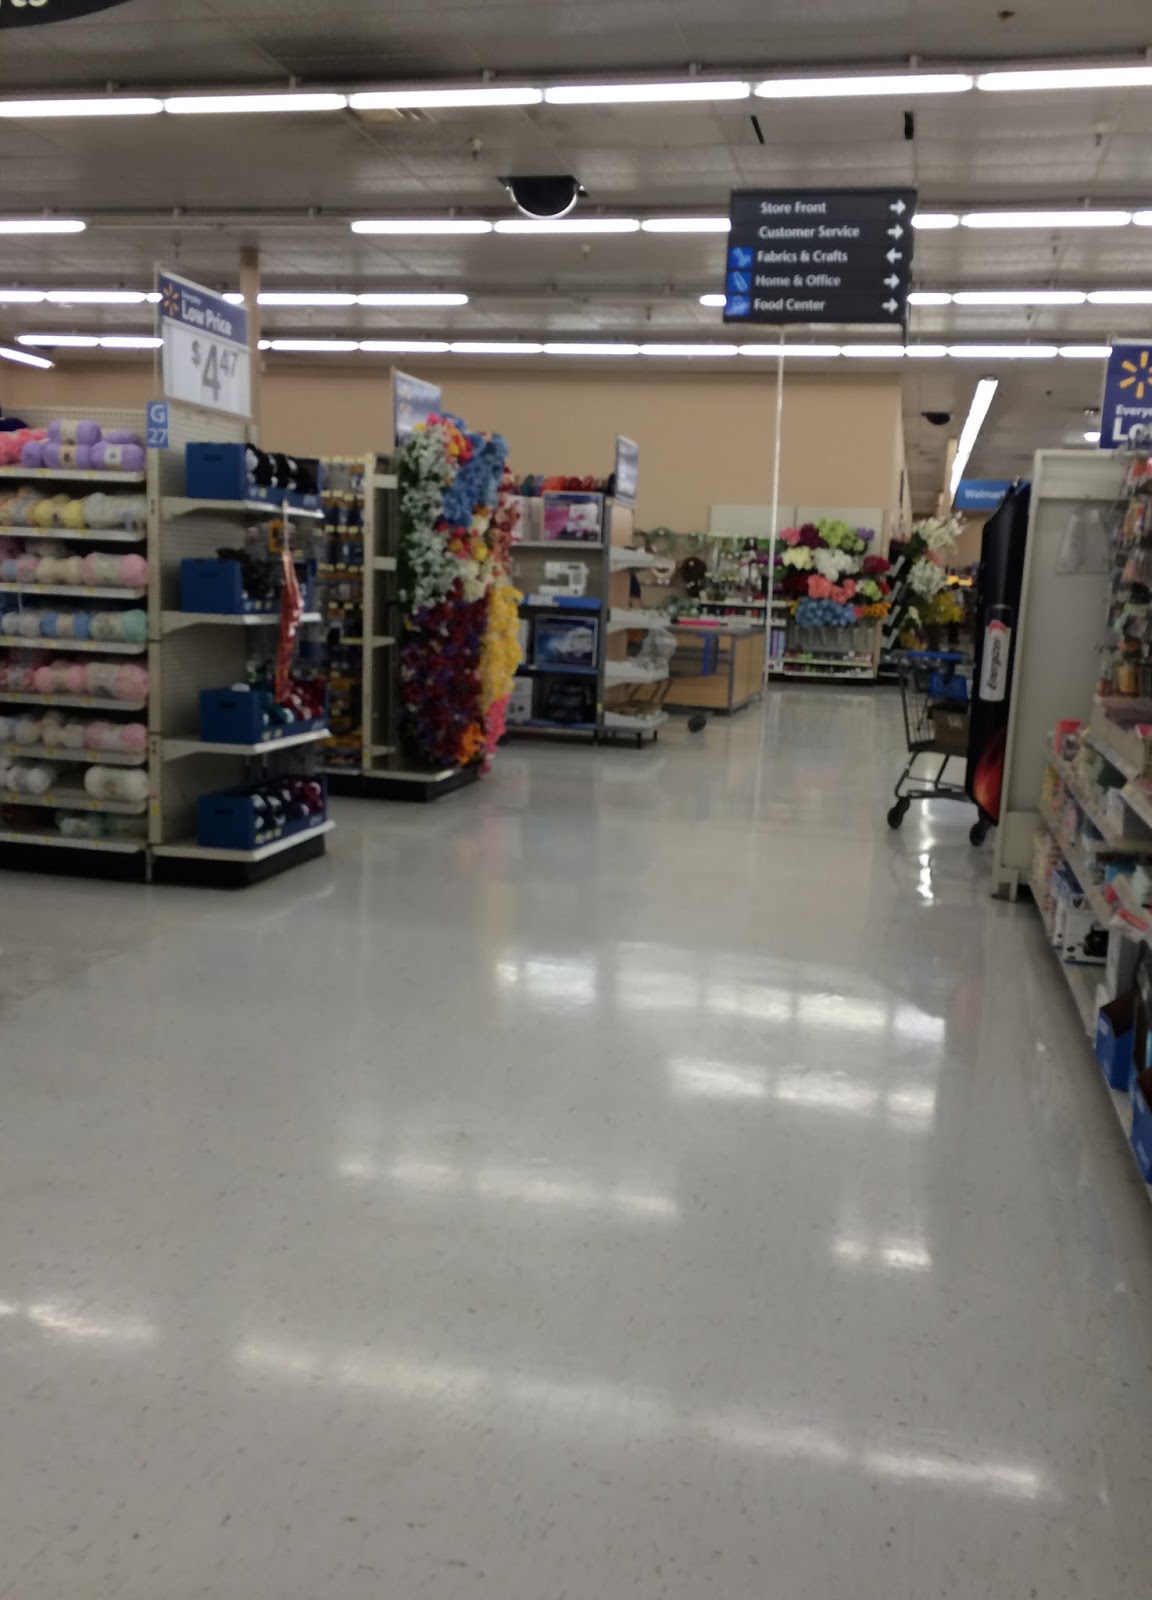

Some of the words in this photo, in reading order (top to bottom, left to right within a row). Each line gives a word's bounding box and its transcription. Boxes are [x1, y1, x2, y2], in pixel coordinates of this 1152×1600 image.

[760, 201, 792, 215] Store
[795, 201, 827, 215] Front
[758, 225, 815, 240] Customer
[818, 225, 860, 239] Service
[756, 250, 798, 264] Fabrics
[800, 251, 810, 263] &
[812, 249, 849, 264] Crafts
[755, 274, 791, 287] Home
[793, 274, 803, 287] &
[806, 273, 841, 288] Office
[753, 298, 783, 311] Food
[785, 298, 826, 312] Center
[181, 298, 205, 325] Low
[205, 308, 233, 336] Price
[150, 404, 166, 423] G
[148, 428, 168, 444] 27
